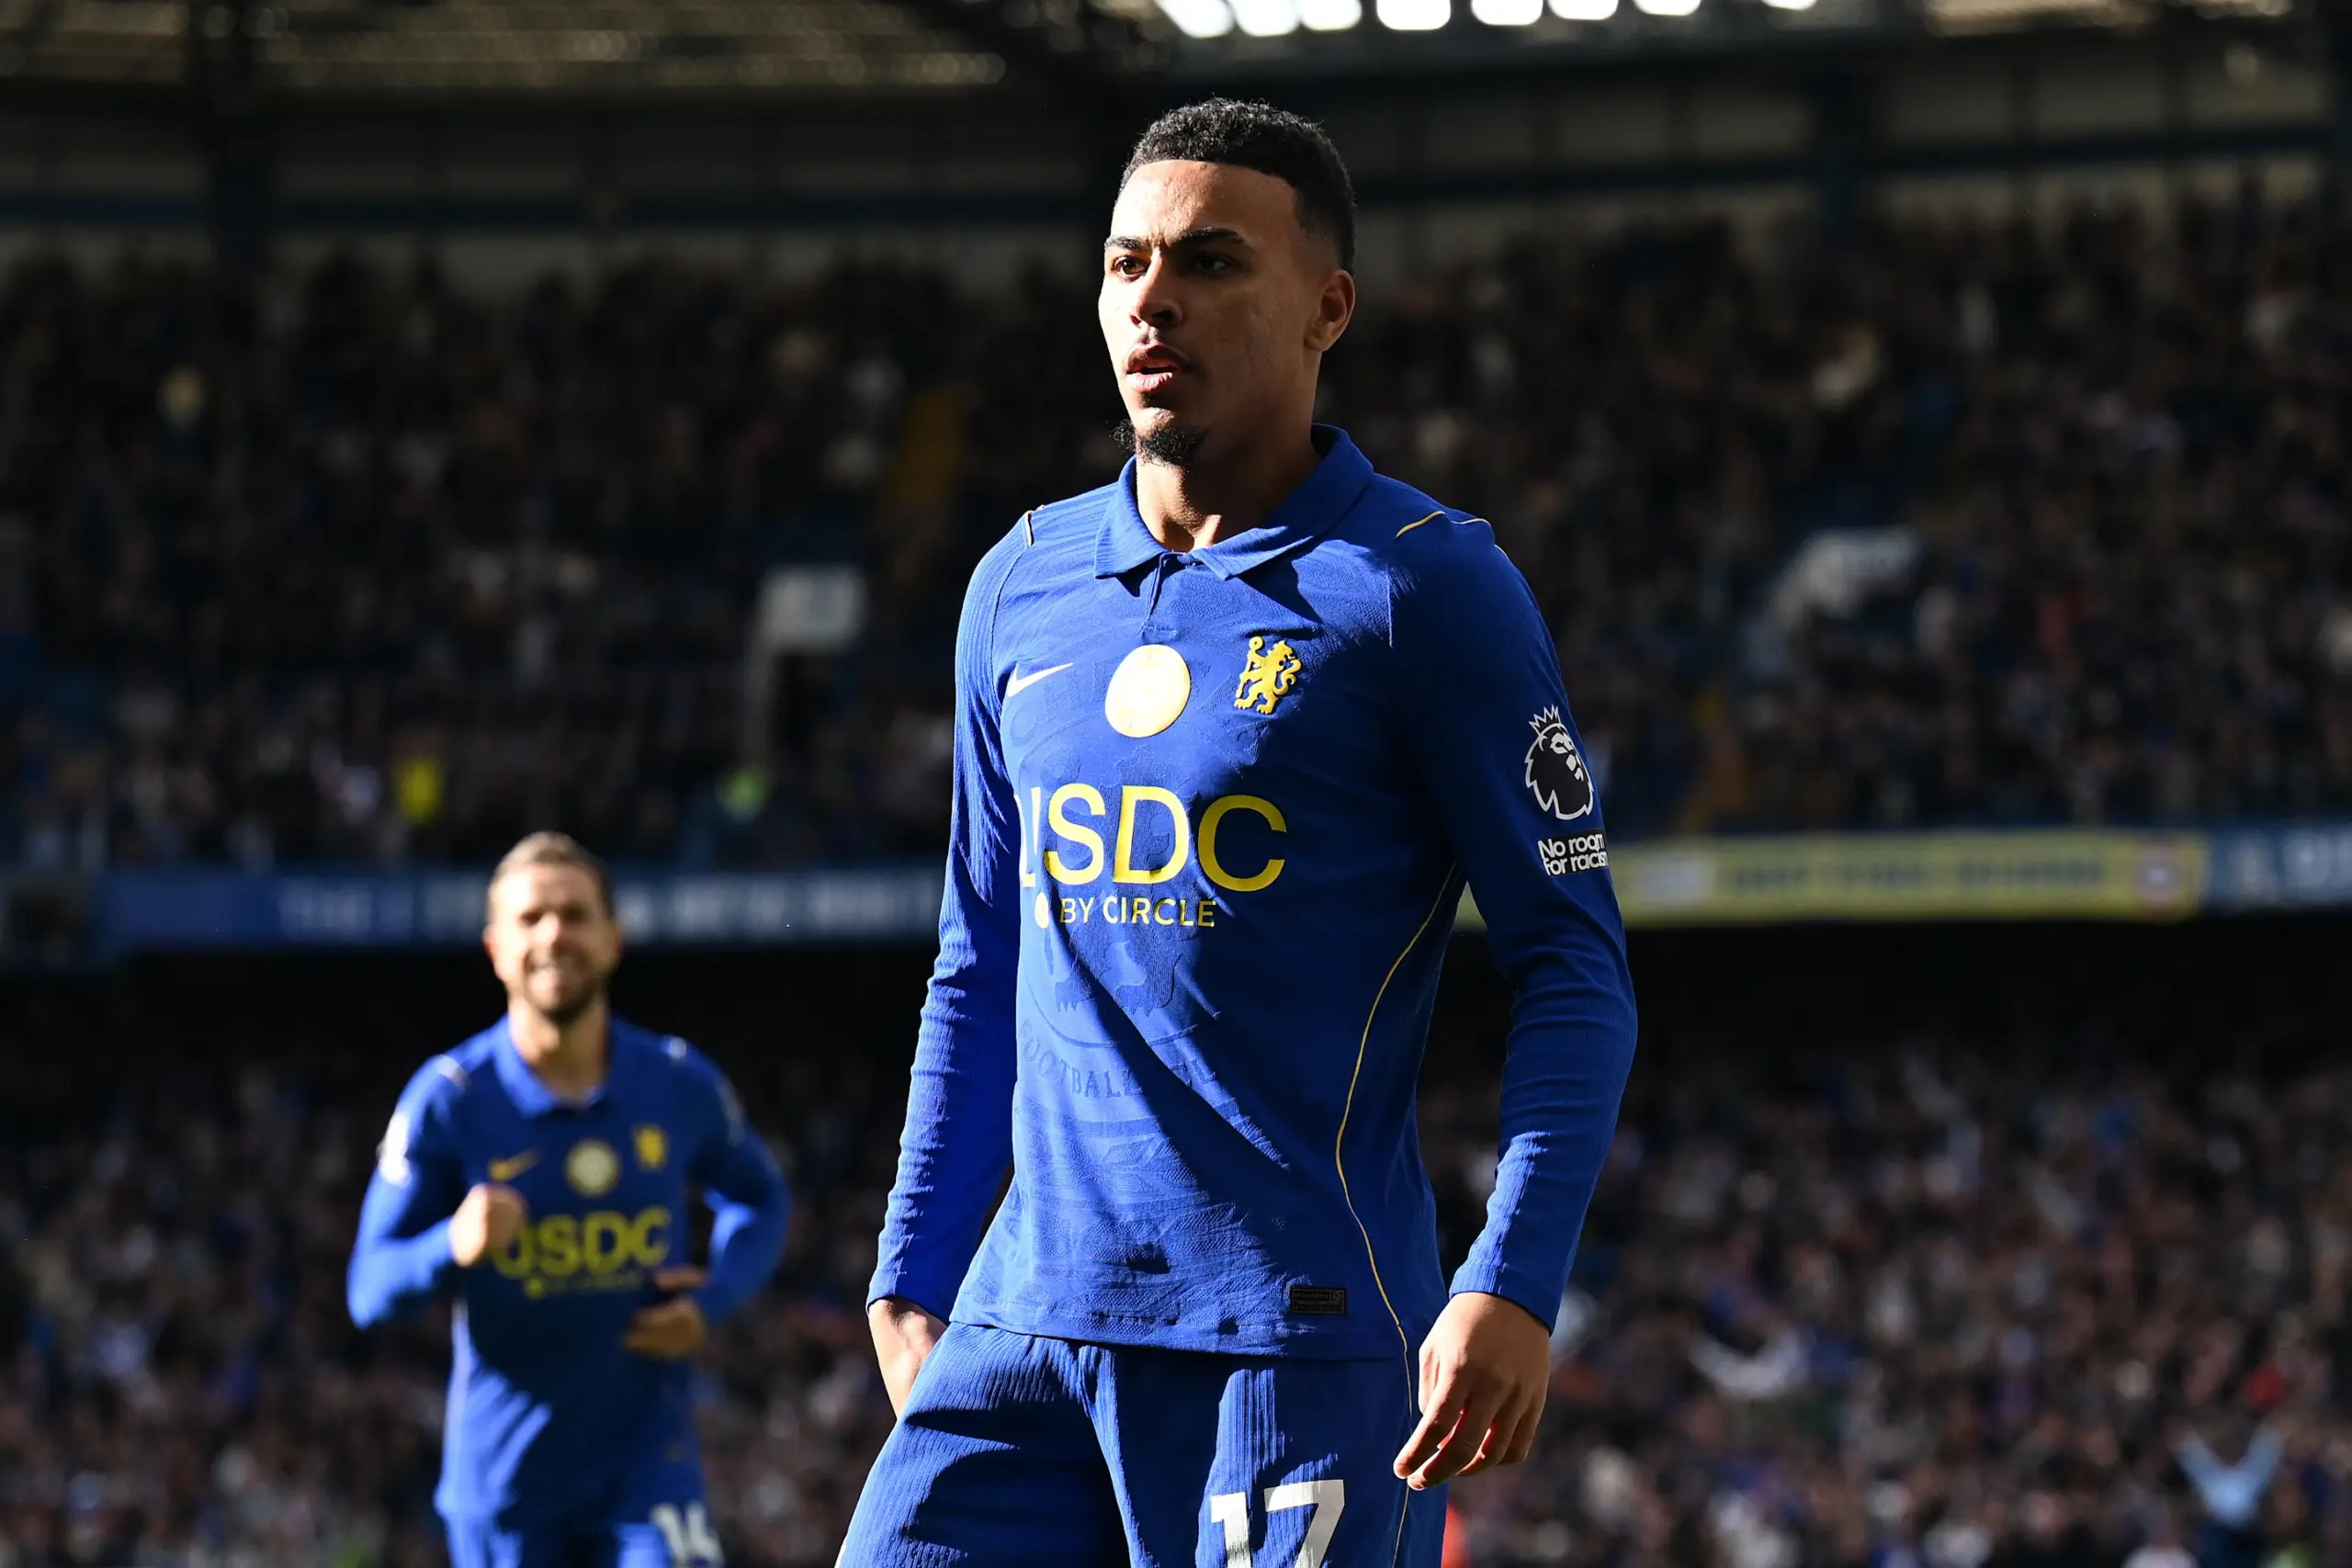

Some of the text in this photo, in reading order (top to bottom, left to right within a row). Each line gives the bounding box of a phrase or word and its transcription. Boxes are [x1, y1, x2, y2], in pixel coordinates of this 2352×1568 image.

[1538, 833, 1605, 859] No room
[1544, 857, 1567, 875] for
[1059, 896, 1216, 927] BY CIRCLE
[1016, 1018, 1143, 1099] FOOTBALL
[1210, 1480, 1346, 1568] 17
